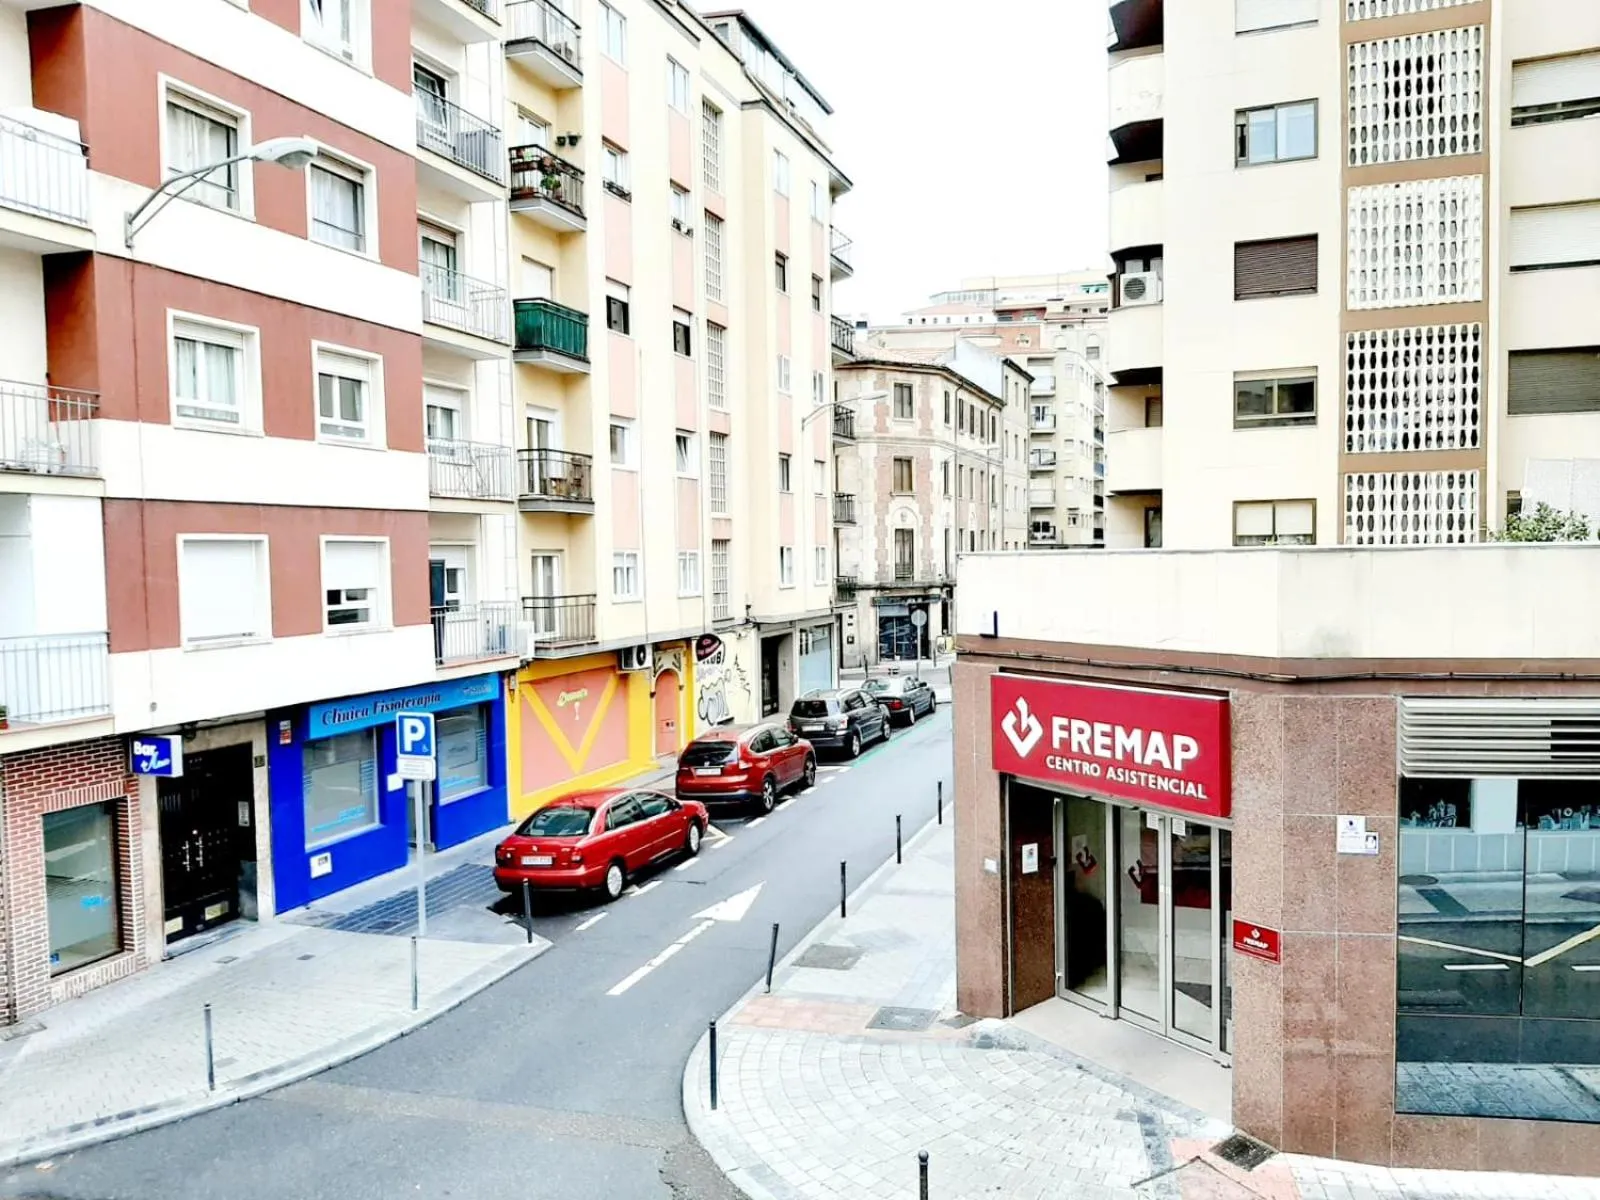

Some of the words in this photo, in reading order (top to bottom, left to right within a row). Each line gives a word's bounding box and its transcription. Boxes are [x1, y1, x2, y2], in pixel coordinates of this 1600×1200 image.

[372, 691, 441, 714] Fisioterapia
[133, 741, 157, 756] Bar
[403, 718, 426, 752] P
[1051, 716, 1199, 771] FREMAP
[1045, 755, 1100, 777] CENTRO
[1106, 766, 1208, 800] ASISTENCIAL
